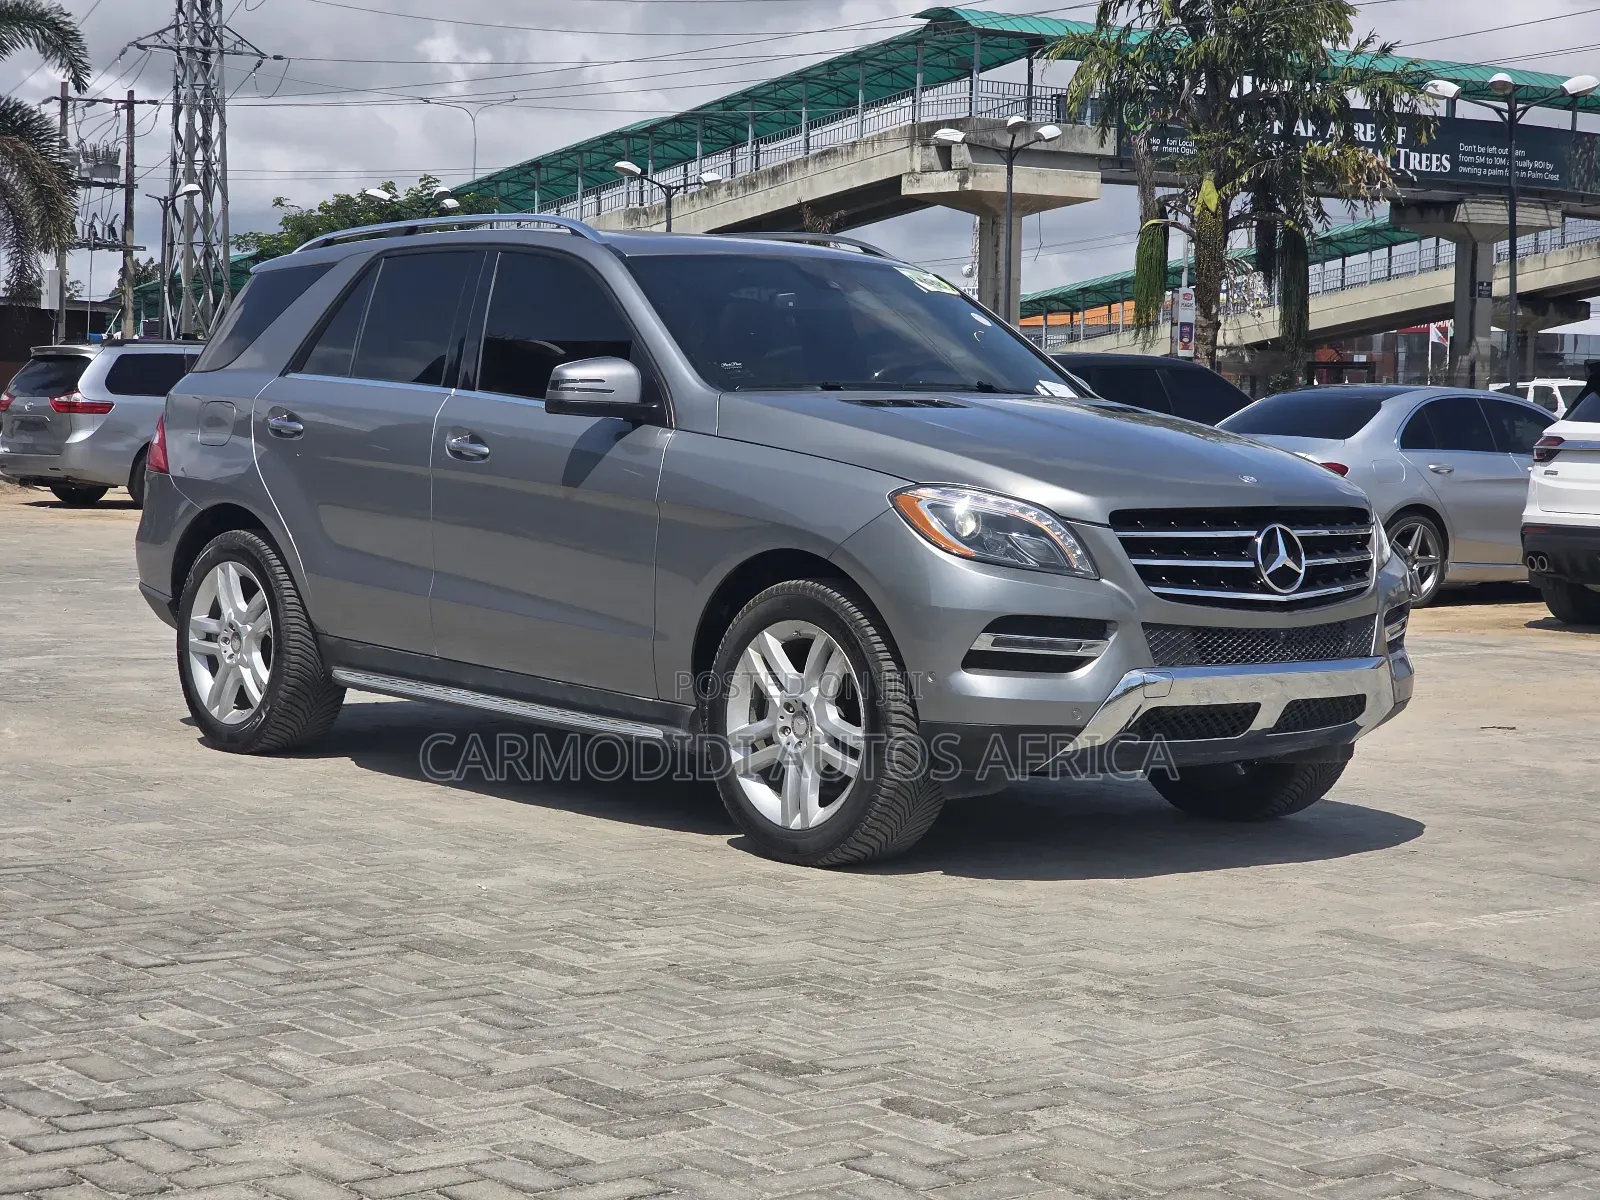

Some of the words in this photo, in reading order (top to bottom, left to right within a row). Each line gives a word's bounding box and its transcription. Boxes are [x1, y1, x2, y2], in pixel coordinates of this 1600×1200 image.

[1178, 139, 1195, 147] Local
[1180, 146, 1198, 155] Ogun
[1459, 143, 1477, 152] Don't
[1477, 145, 1486, 153] be
[1486, 146, 1497, 154] left
[1514, 149, 1526, 157] arn
[1396, 147, 1451, 173] TREES
[1458, 153, 1475, 162] from
[1475, 155, 1486, 164] 5M
[1486, 157, 1493, 165] to
[1494, 157, 1506, 166] 10M
[1534, 160, 1545, 169] ROI
[1546, 162, 1554, 171] by
[1458, 165, 1482, 176] owning
[1487, 167, 1504, 177] palm
[1519, 169, 1527, 178] in
[1527, 170, 1543, 179] Palm
[1544, 172, 1560, 181] Crest
